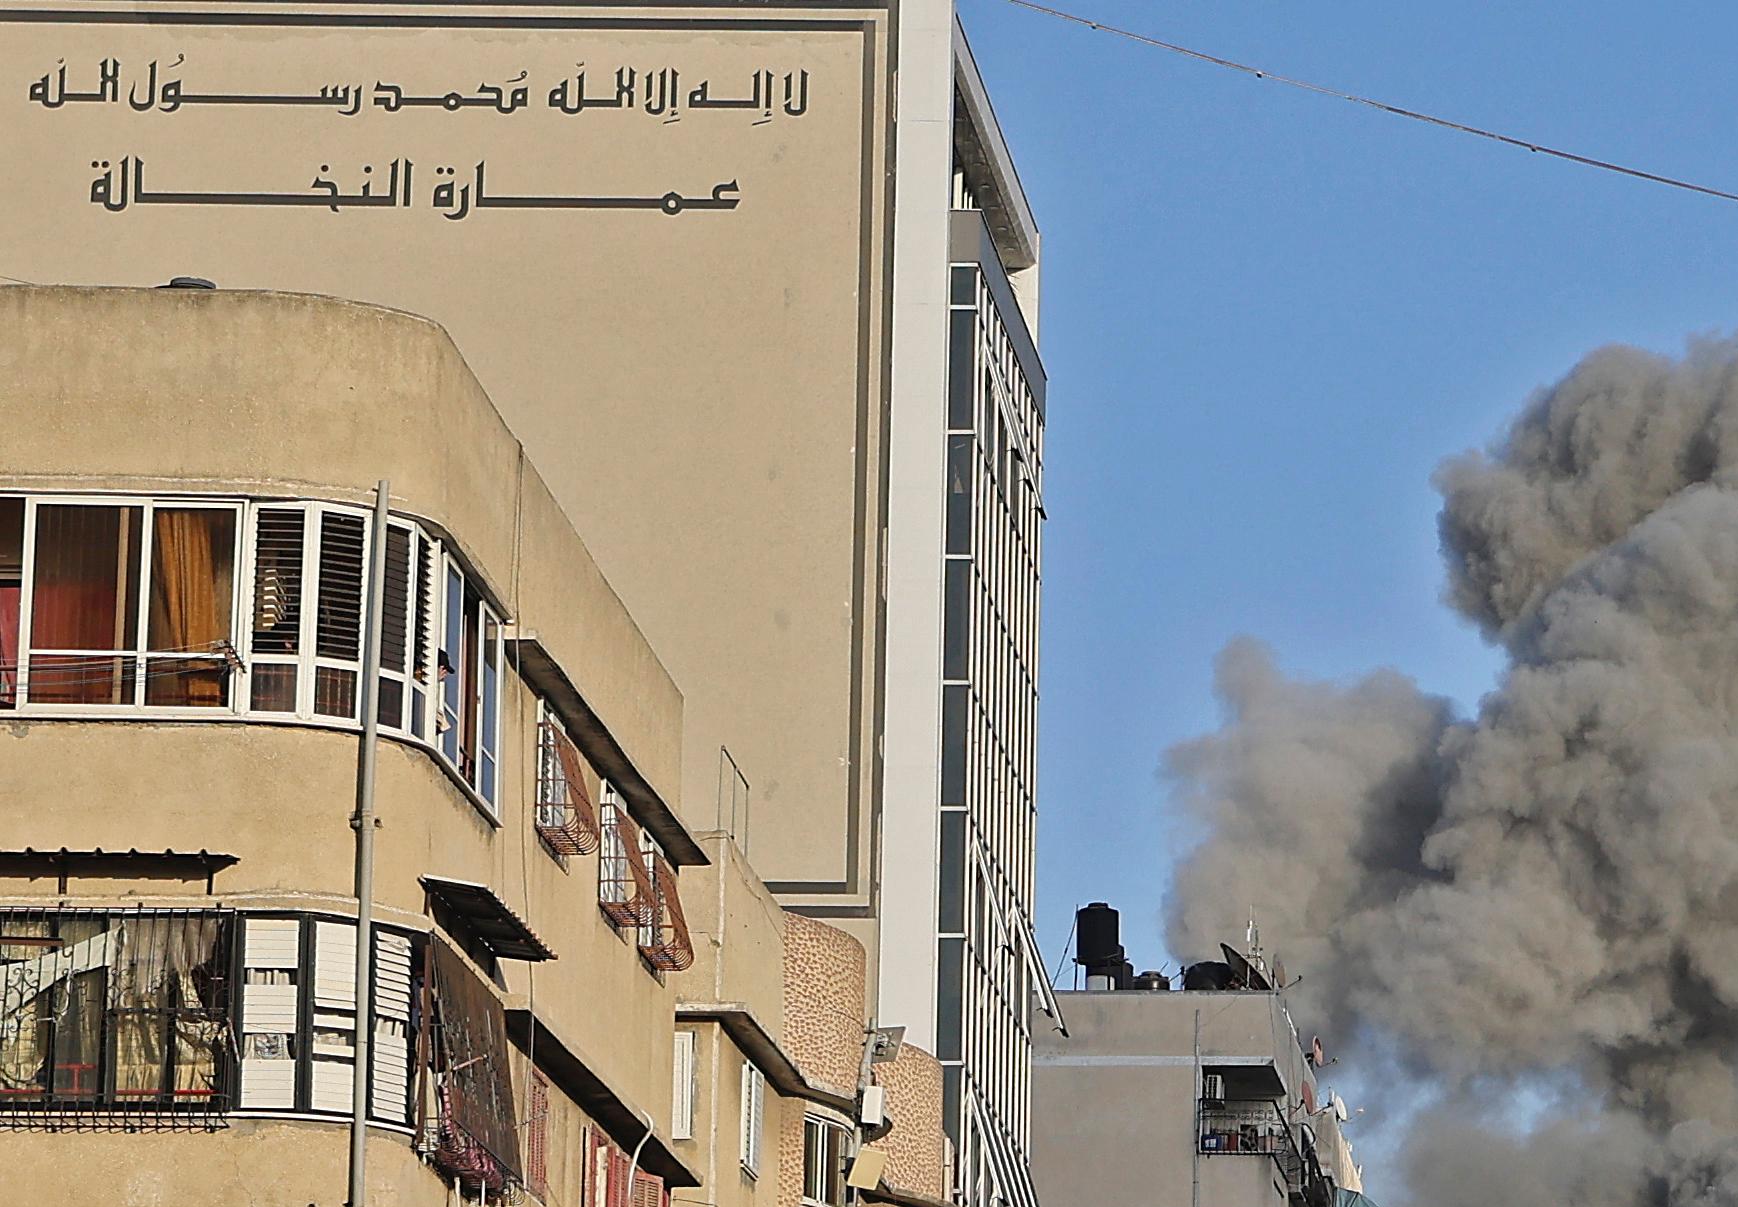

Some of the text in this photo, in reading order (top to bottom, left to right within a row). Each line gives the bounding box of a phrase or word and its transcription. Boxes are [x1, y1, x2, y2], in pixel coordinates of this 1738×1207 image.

[783, 68, 809, 117] لا
[90, 155, 741, 221] عمارة النخالة
